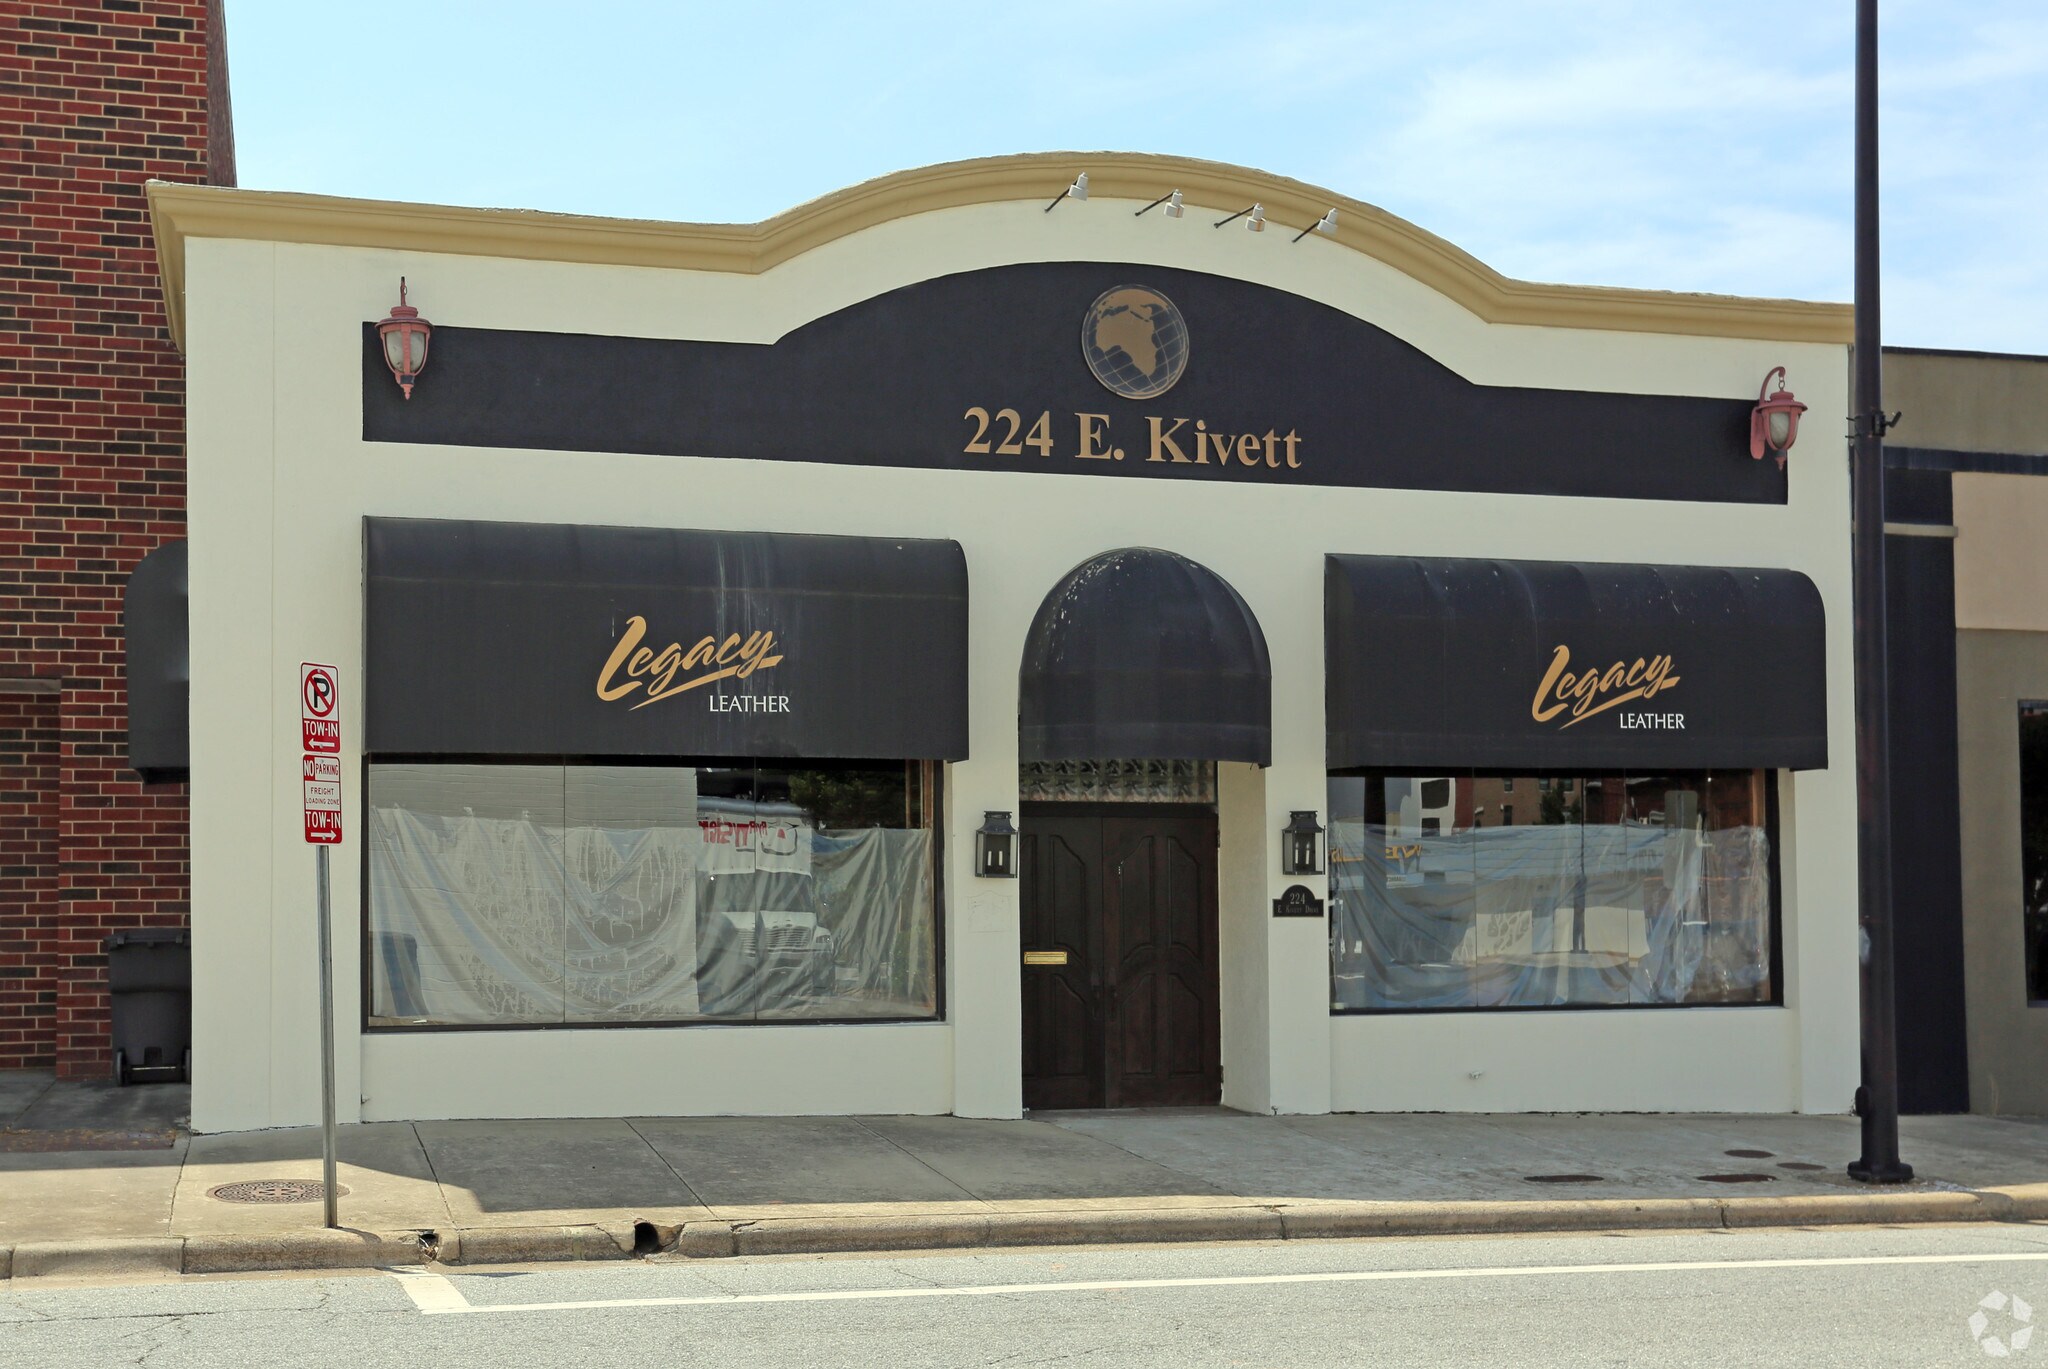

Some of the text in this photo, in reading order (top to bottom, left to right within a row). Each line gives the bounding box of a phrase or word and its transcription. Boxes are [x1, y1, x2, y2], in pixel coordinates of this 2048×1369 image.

[963, 406, 1302, 469] 224 E. Kivett
[597, 615, 783, 702] Legacy
[1532, 644, 1680, 722] Legacy
[709, 695, 791, 712] LEATHER
[304, 720, 338, 737] TOW-IN
[1619, 713, 1686, 729] LEATHER
[303, 759, 339, 777] NO PARKING
[310, 786, 334, 796] FREIGHT
[306, 797, 340, 806] LOADING ZONE
[305, 810, 341, 829] TOW-IN
[1289, 892, 1306, 905] 224
